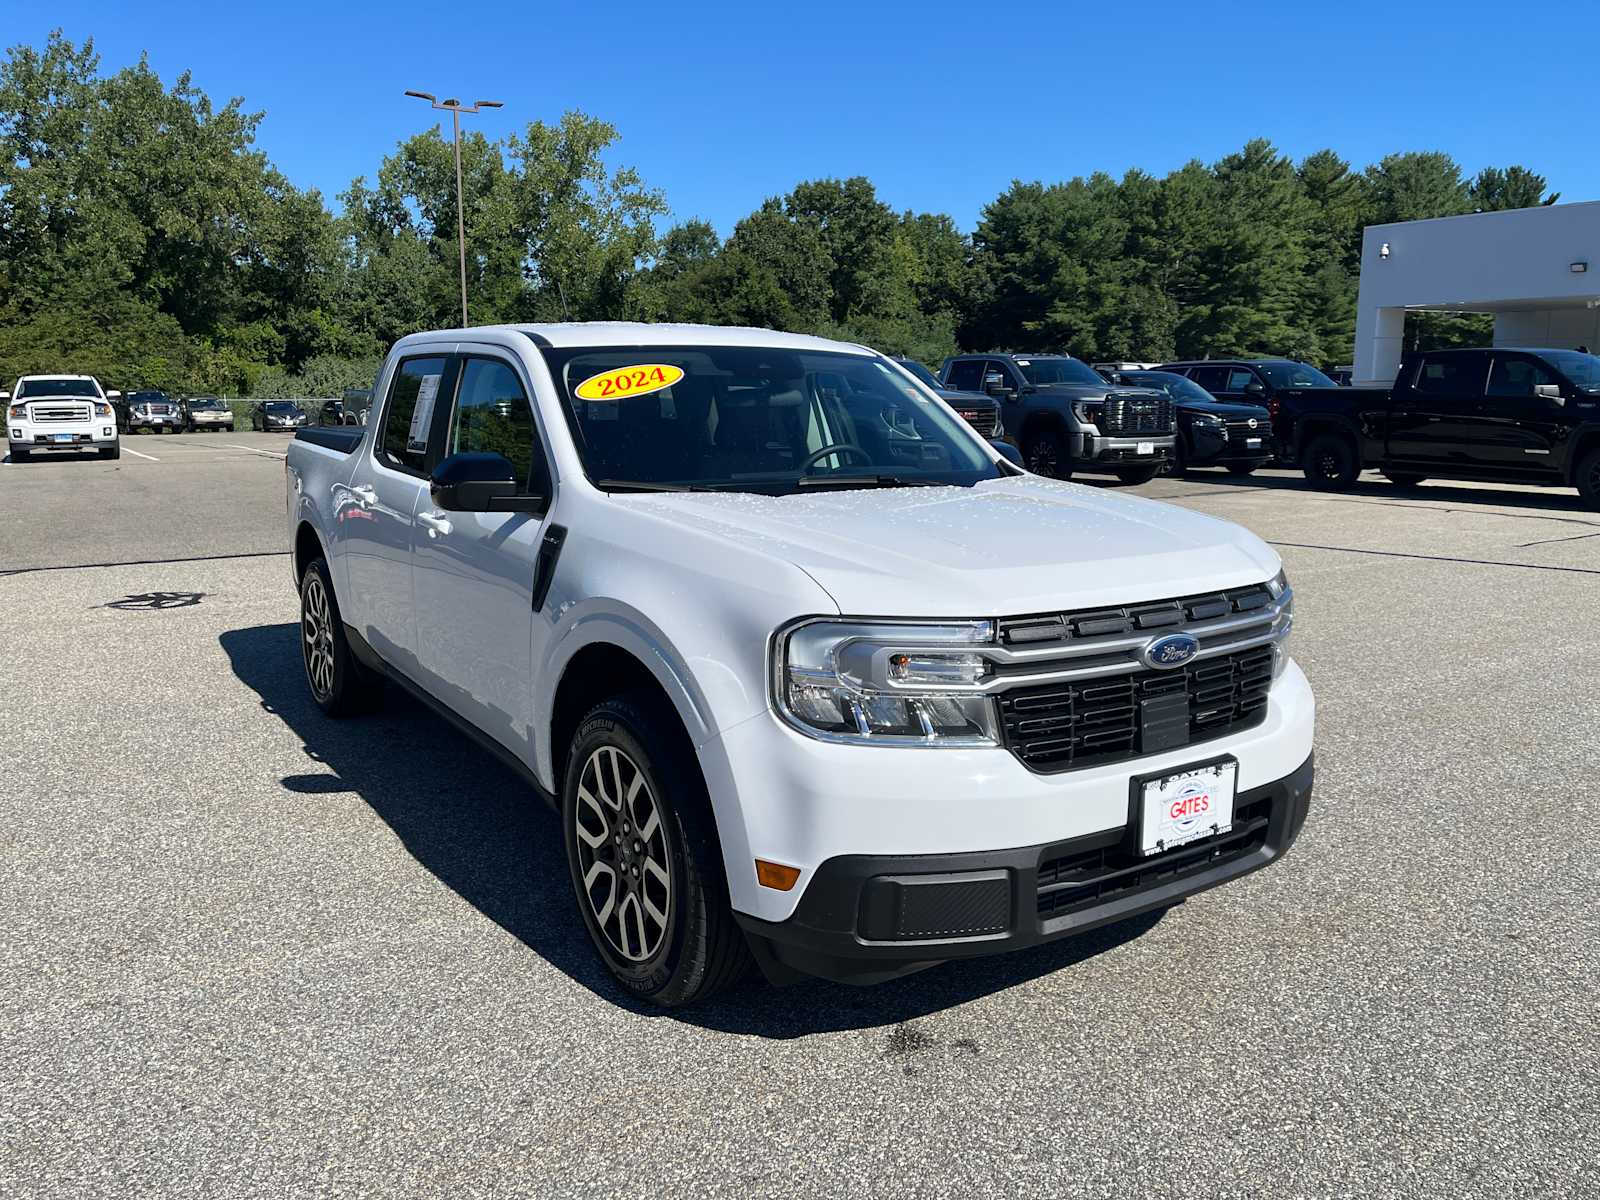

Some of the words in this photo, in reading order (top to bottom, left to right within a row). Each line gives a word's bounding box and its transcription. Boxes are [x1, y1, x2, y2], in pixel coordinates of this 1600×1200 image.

[597, 367, 666, 396] 2024
[1161, 645, 1189, 661] Ford
[1168, 766, 1217, 783] GATES
[1170, 795, 1209, 818] GATES
